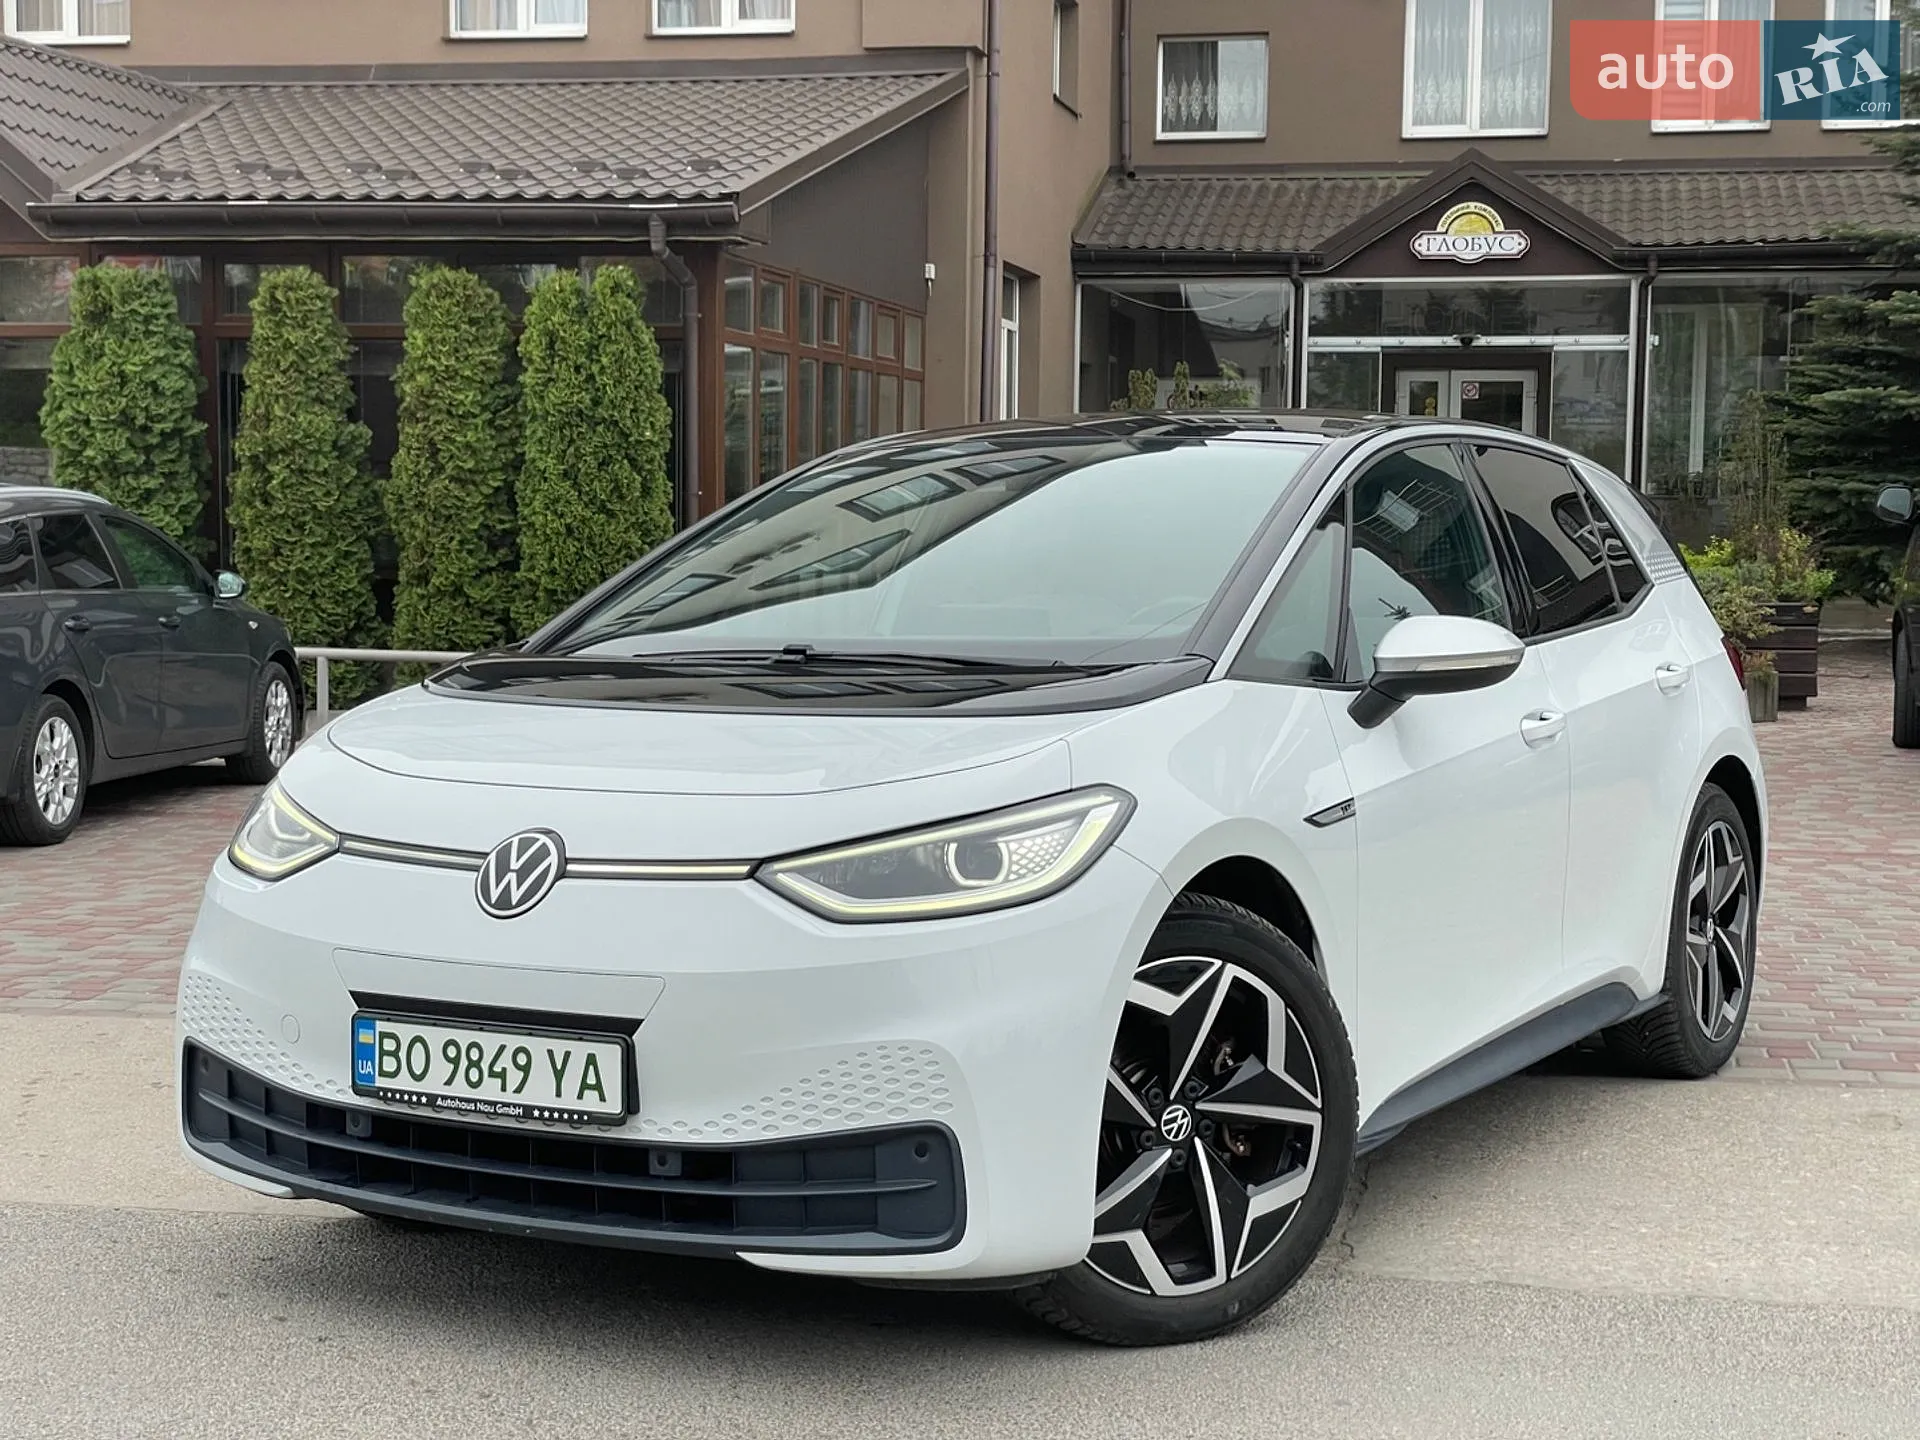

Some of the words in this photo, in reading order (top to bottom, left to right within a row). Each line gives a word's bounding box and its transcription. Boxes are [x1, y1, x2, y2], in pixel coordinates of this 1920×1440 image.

[1425, 236, 1516, 254] ГЛОБУС
[483, 835, 557, 911] VW
[358, 1059, 374, 1075] UA
[378, 1030, 431, 1083] BO
[442, 1038, 532, 1094] 9849
[546, 1048, 607, 1103] YA
[435, 1097, 476, 1111] Autohaus
[476, 1102, 494, 1113] Nau
[496, 1103, 523, 1116] GmbH
